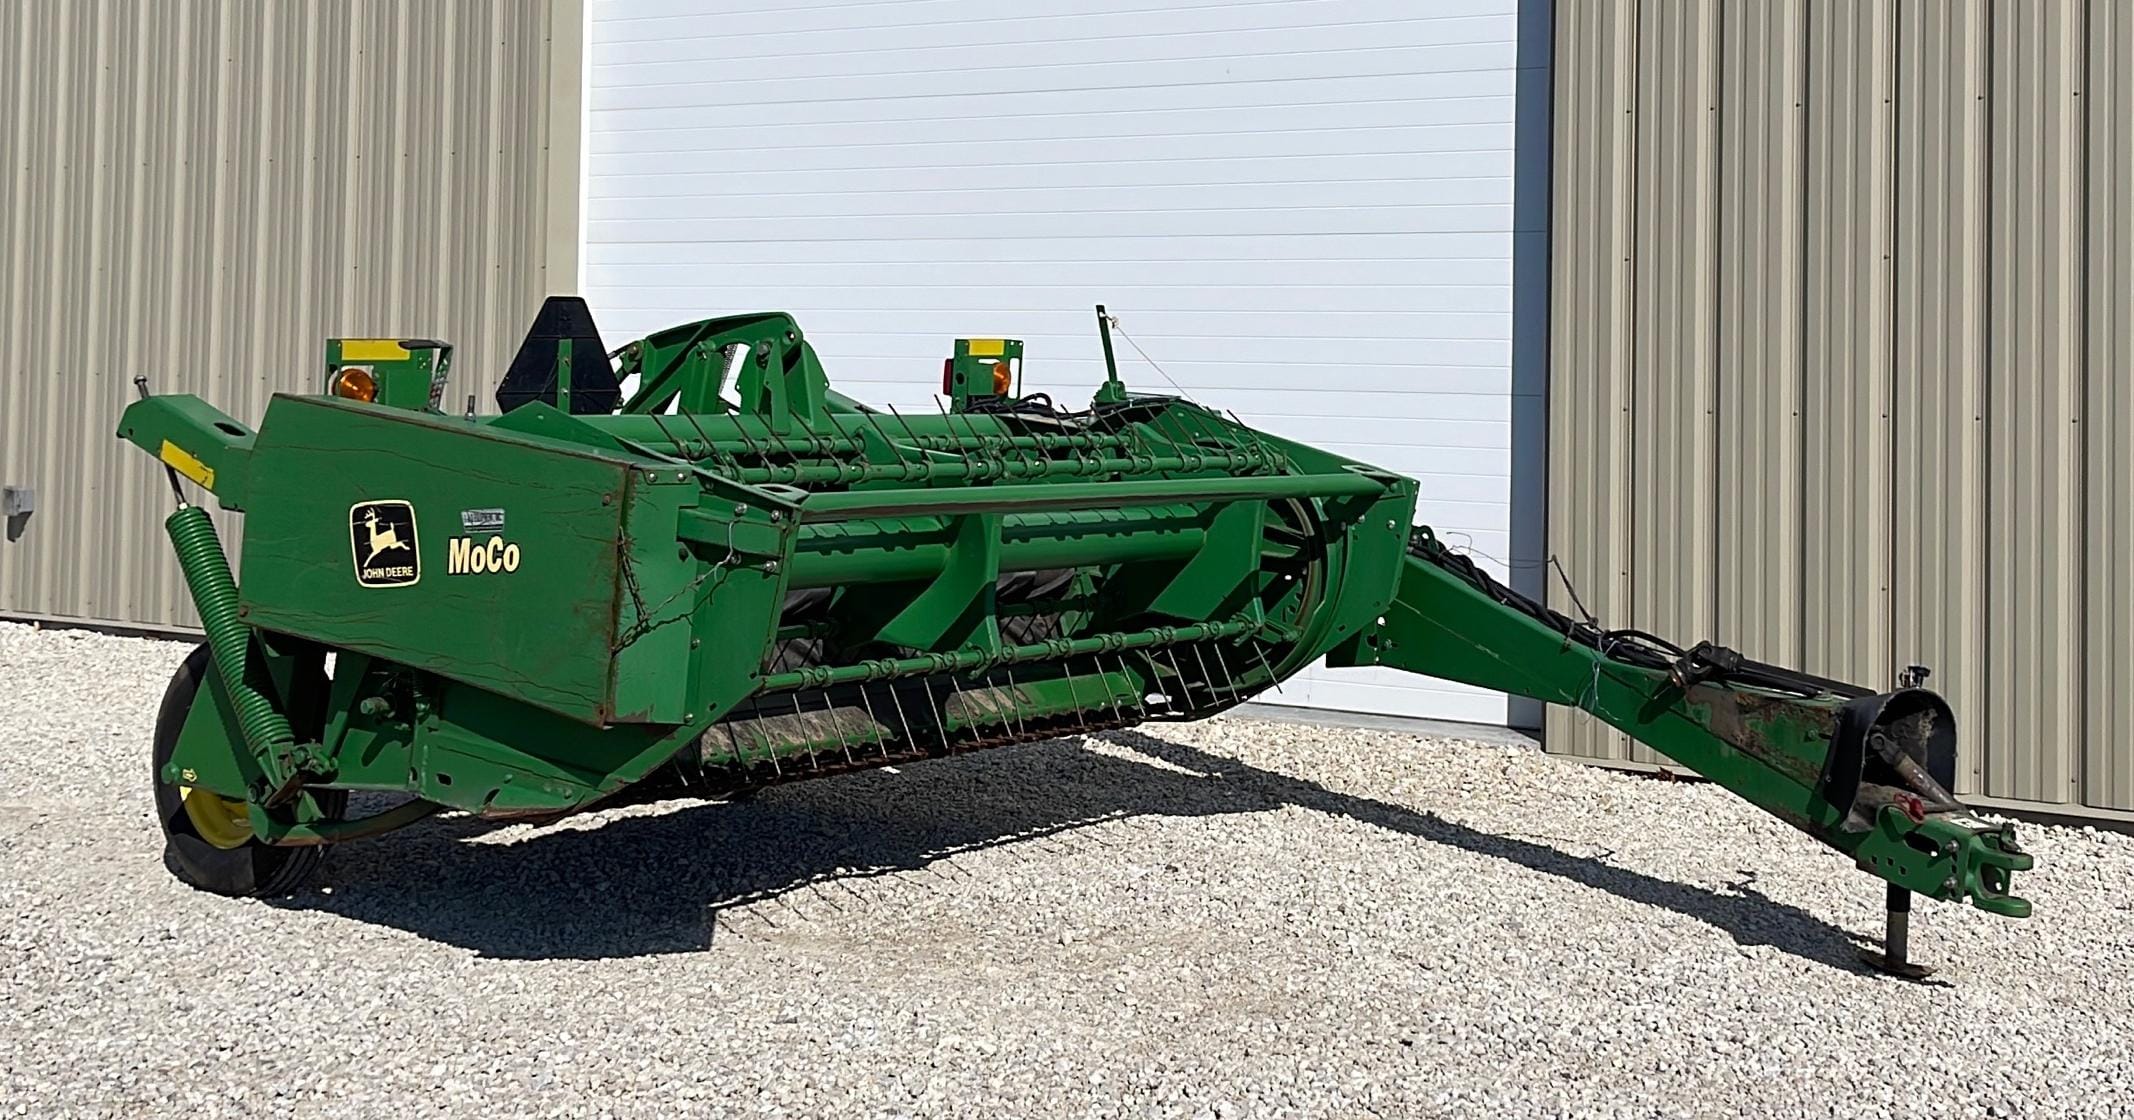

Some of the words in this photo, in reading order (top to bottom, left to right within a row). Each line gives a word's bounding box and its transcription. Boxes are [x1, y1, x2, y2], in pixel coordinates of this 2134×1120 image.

[448, 535, 520, 574] MoCo
[362, 567, 384, 579] JOHN
[385, 566, 414, 577] DEERE
